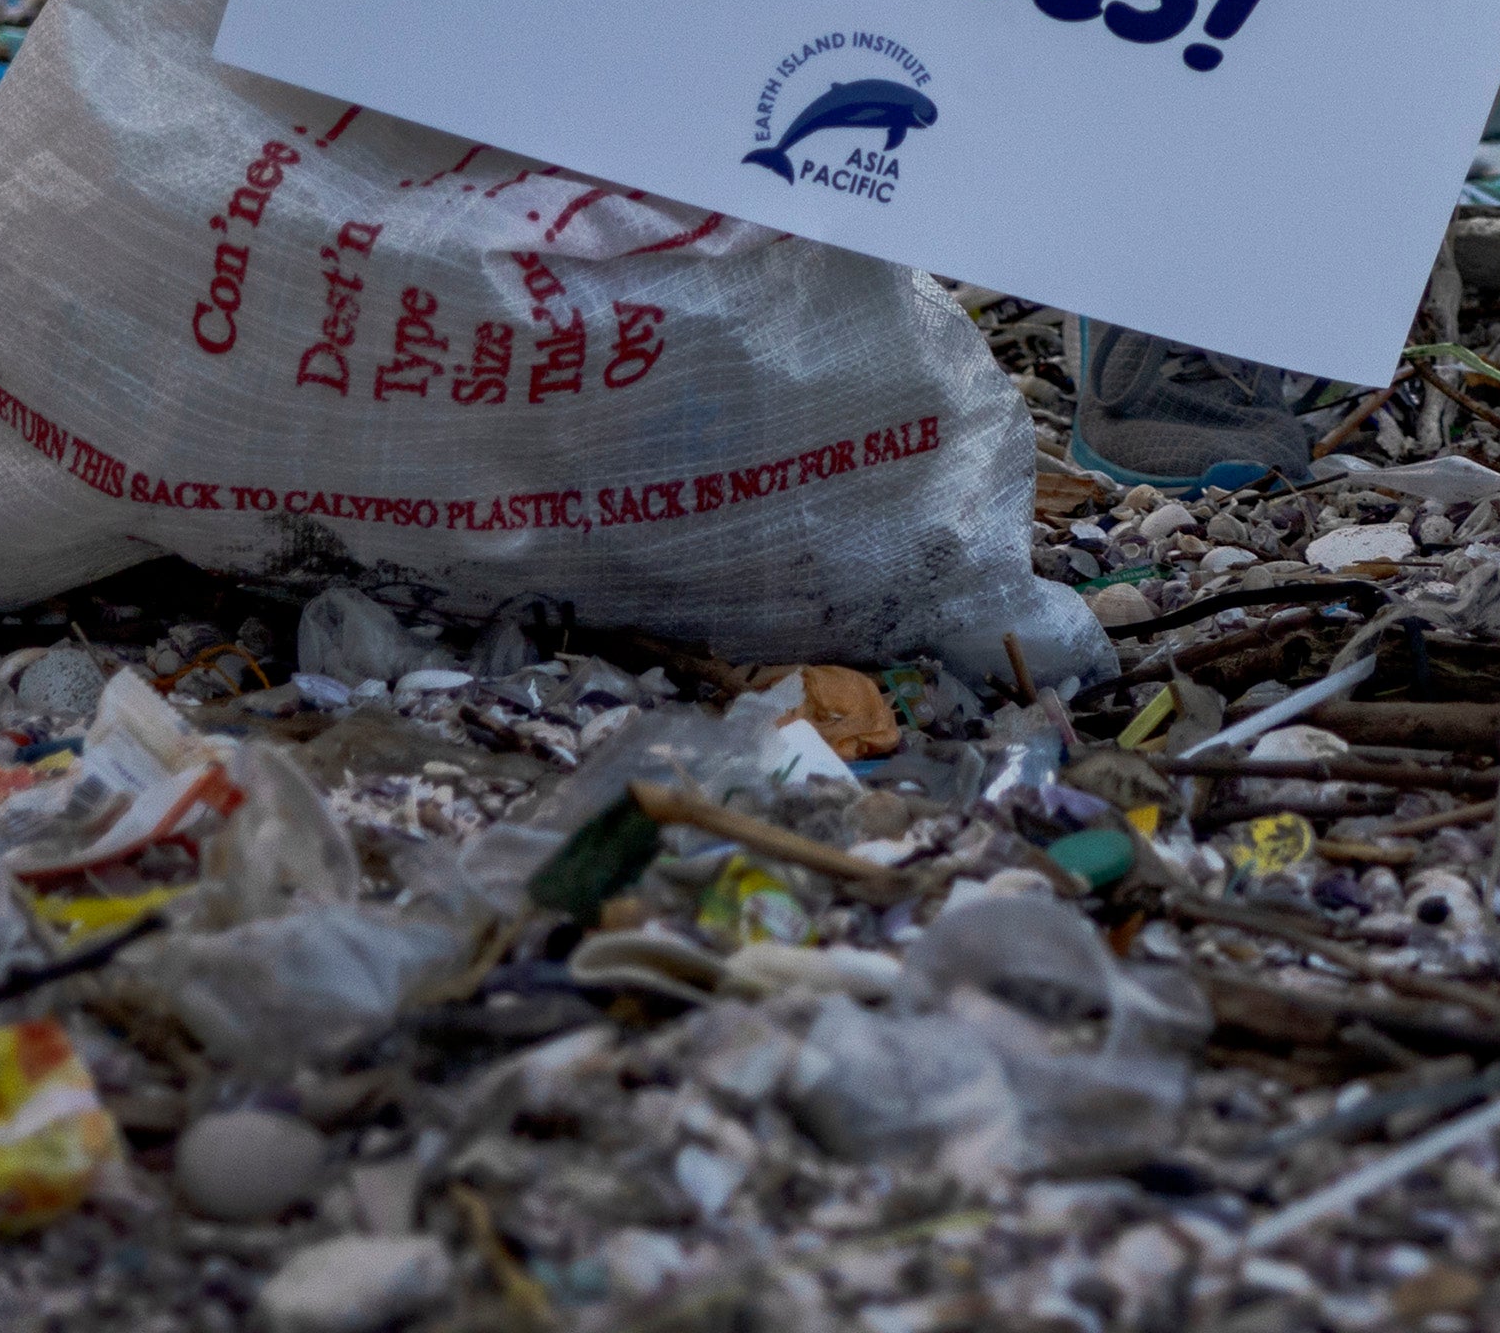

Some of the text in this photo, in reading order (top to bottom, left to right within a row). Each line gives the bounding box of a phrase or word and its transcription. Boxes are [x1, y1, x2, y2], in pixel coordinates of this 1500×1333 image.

[755, 32, 932, 141] EARTH ISLAND INSTITUTE
[800, 159, 895, 203] PACIFIC
[845, 147, 899, 179] ASIA
[373, 287, 449, 401] Type
[451, 321, 514, 404] Size
[603, 300, 665, 388] Qty
[67, 436, 127, 499] THIS
[130, 472, 223, 510] SACK
[230, 485, 278, 511] TO
[283, 490, 439, 528] CALYPSO
[446, 489, 593, 533] PLASTIC,
[597, 481, 689, 526] SACK
[692, 472, 725, 513] IS
[728, 456, 796, 504] NOT
[796, 439, 856, 486] FOR
[863, 415, 941, 467] SALE
